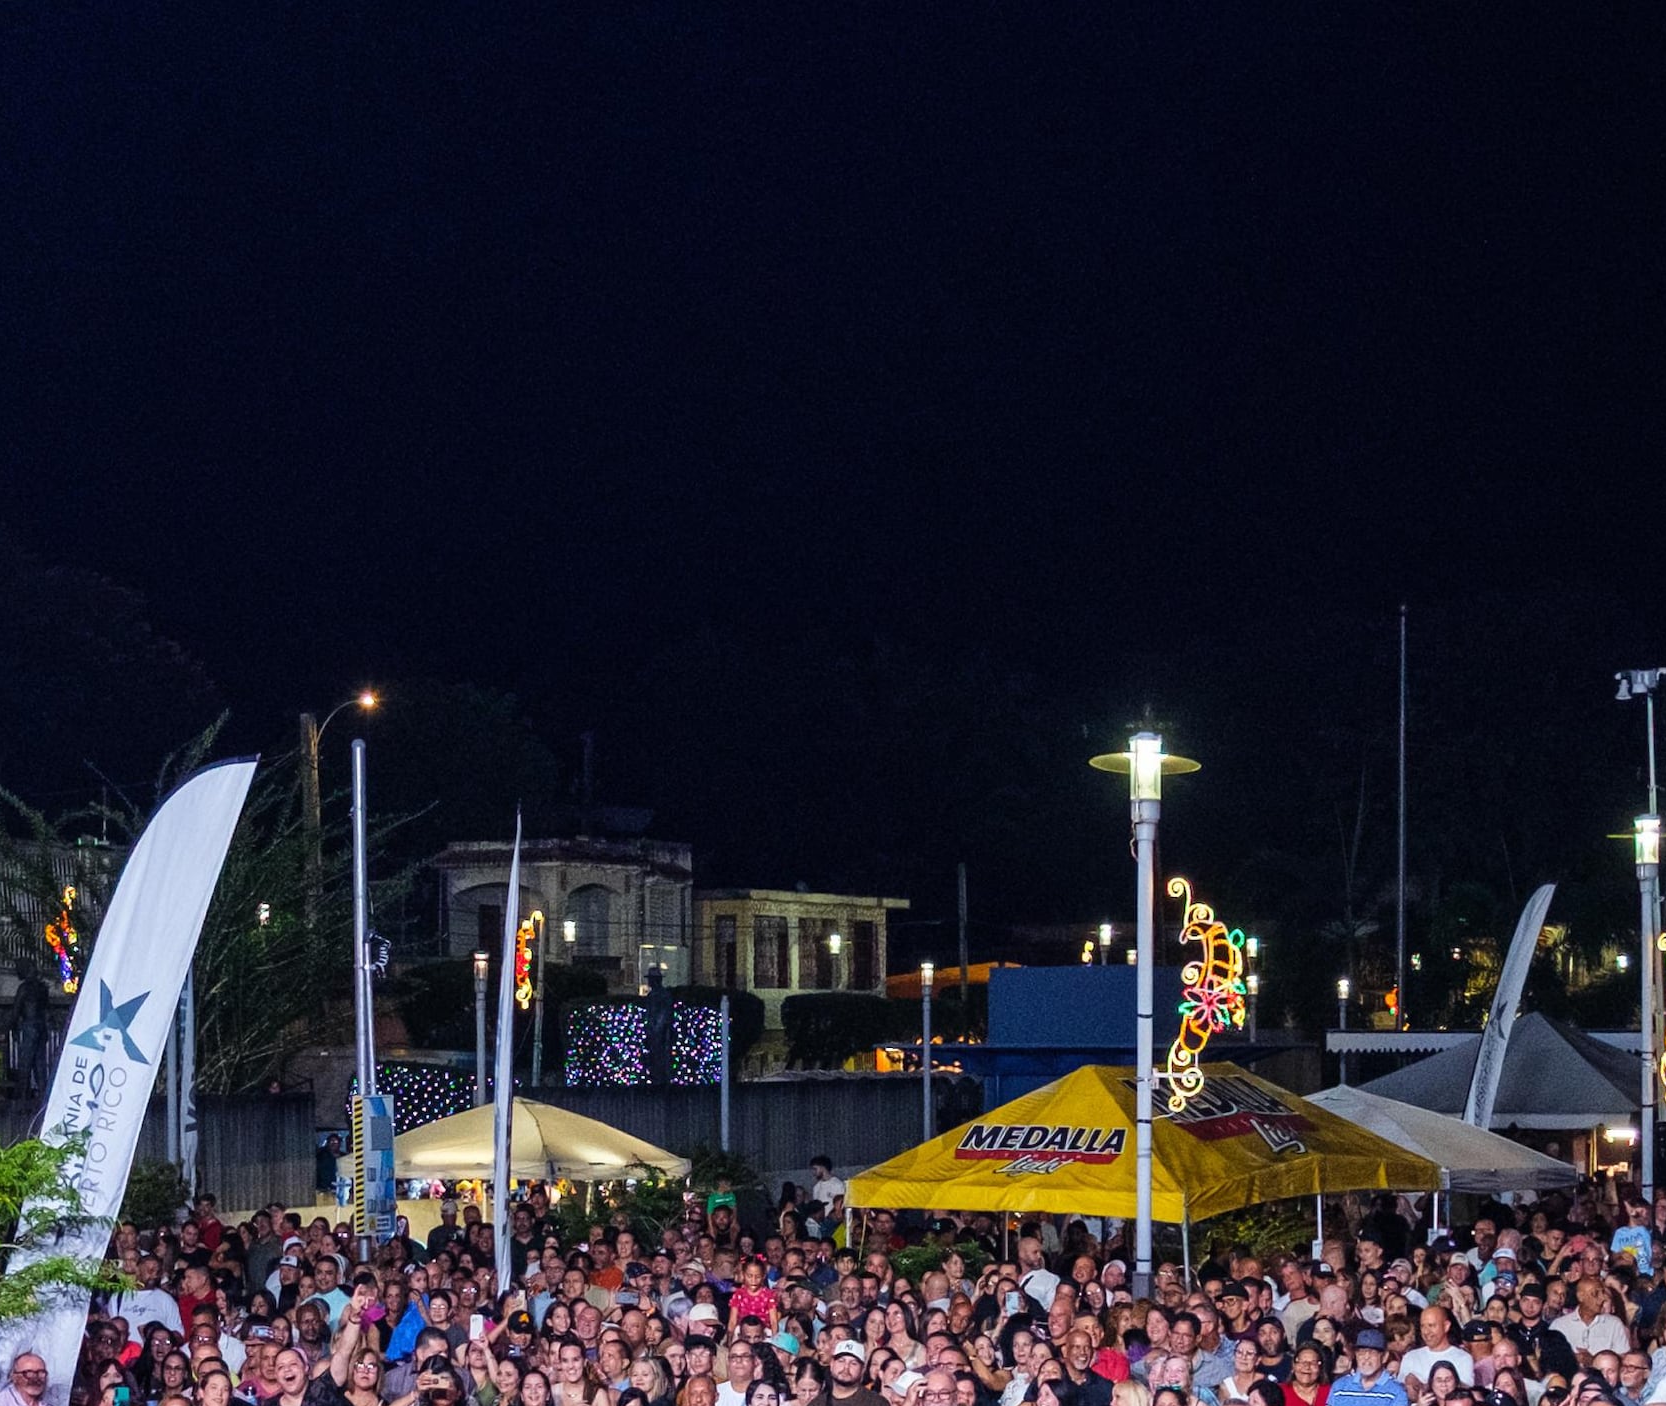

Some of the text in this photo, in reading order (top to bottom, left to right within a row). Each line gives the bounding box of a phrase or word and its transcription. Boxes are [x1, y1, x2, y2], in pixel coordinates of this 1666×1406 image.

[73, 1057, 88, 1085] DE
[97, 1067, 127, 1132] RICO
[959, 1125, 1128, 1155] MEDALLA
[993, 1154, 1075, 1178] Light
